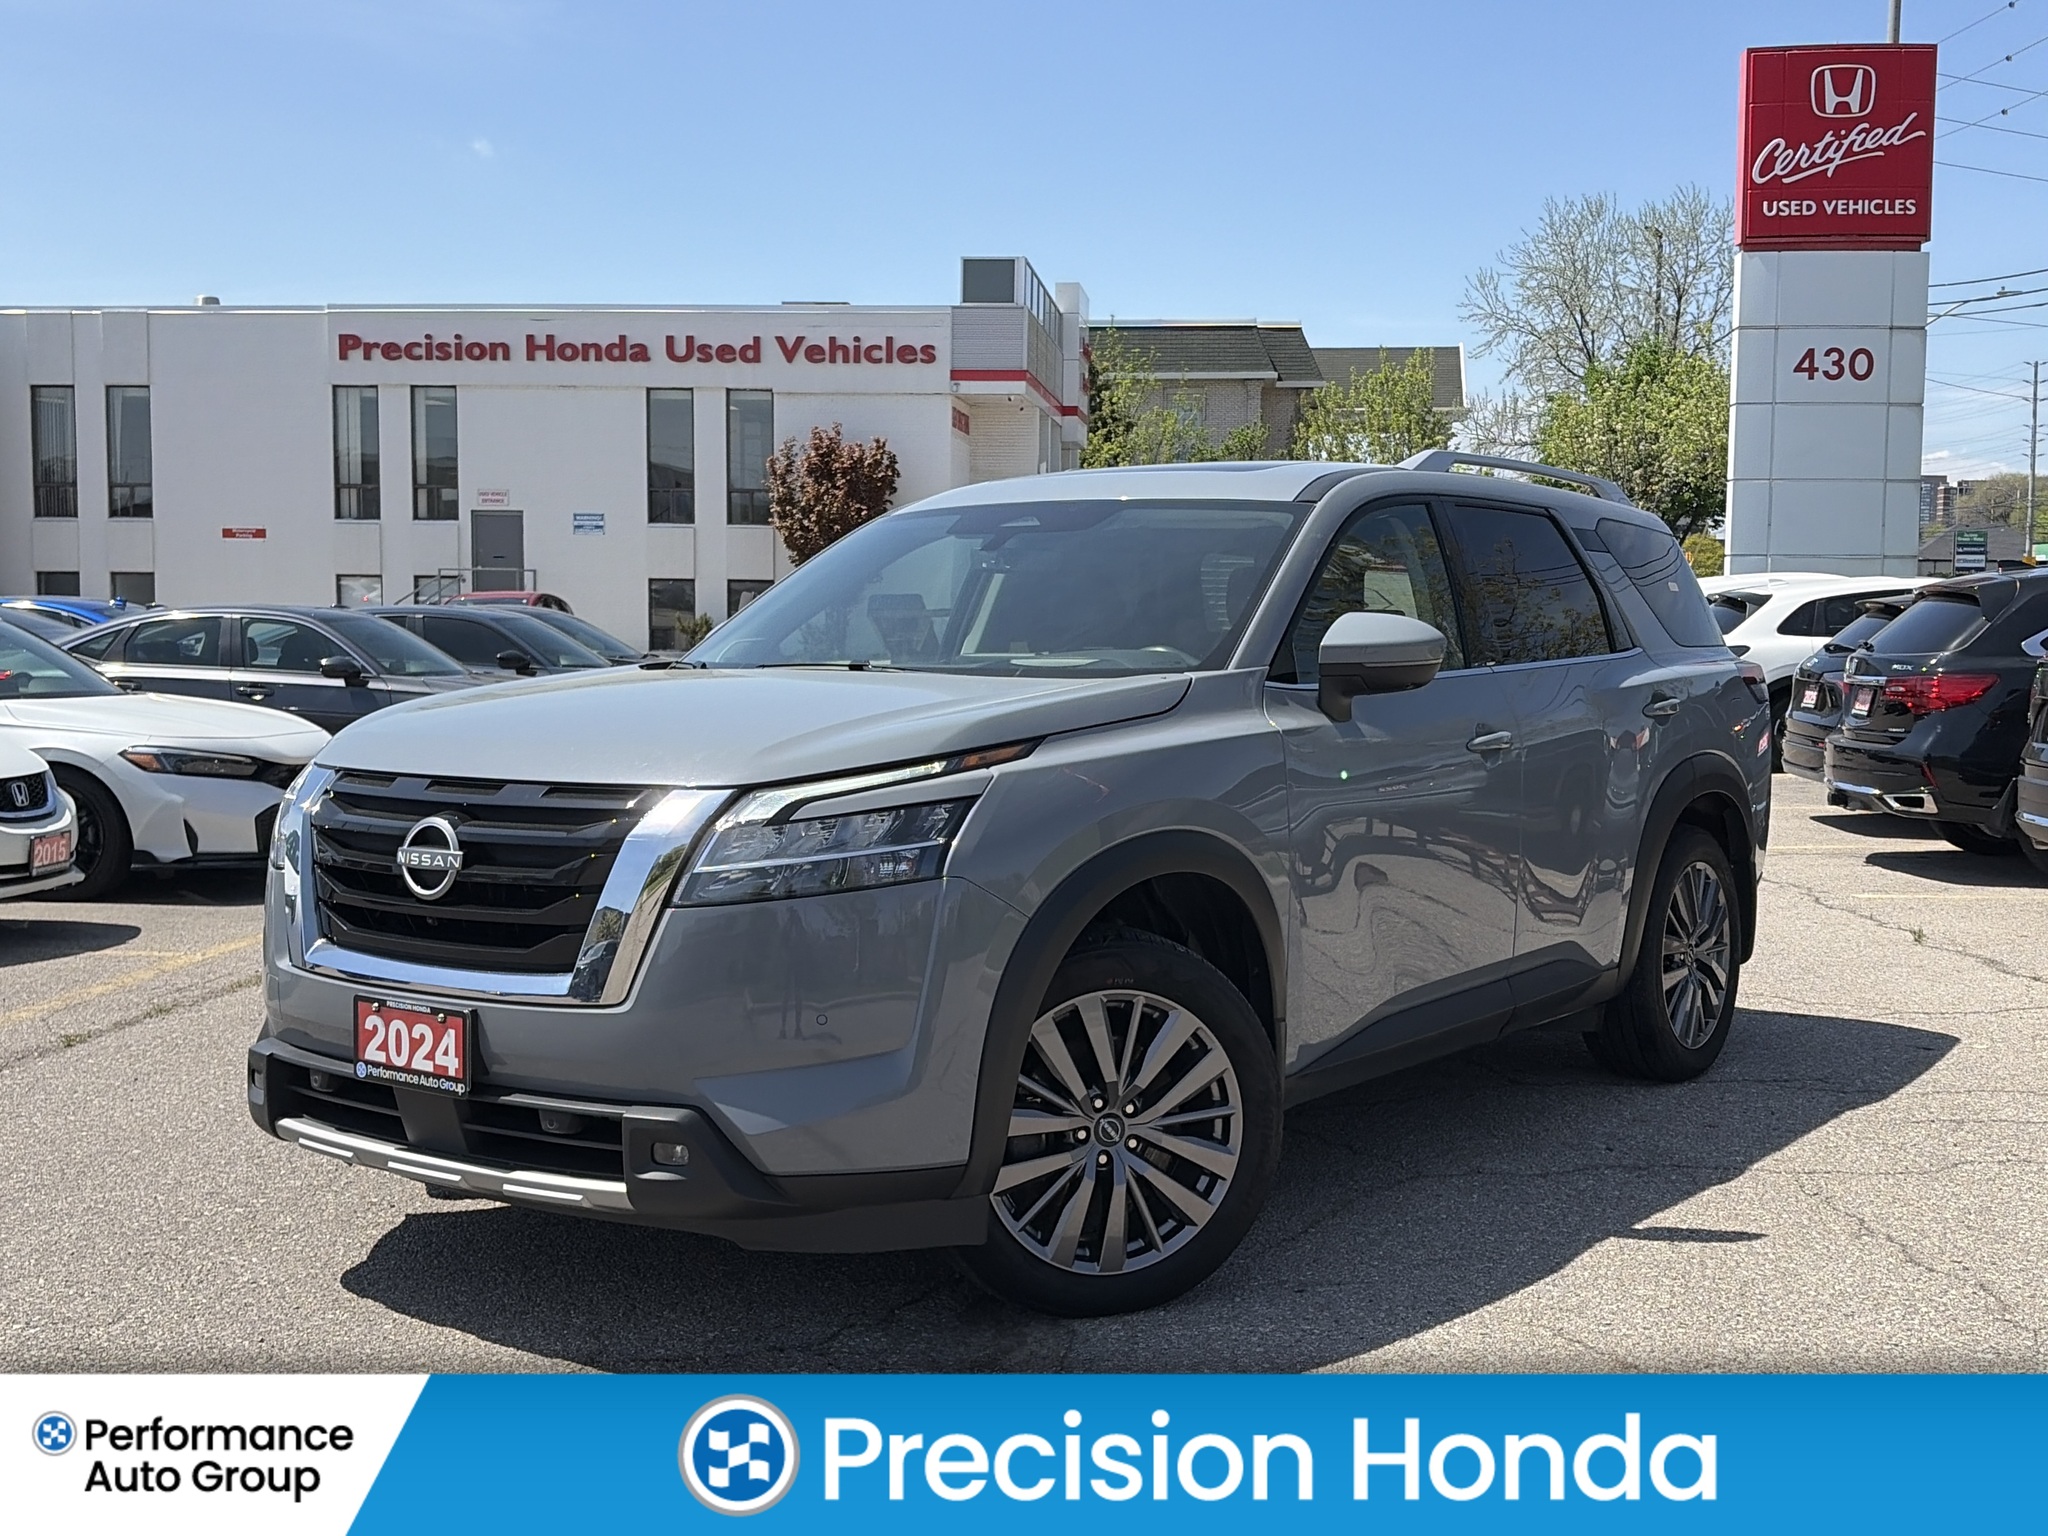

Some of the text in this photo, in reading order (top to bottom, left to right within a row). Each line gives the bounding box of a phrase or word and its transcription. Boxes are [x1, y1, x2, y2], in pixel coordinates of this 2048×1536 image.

[1751, 112, 1926, 184] Certified
[1763, 199, 1917, 216] USED VEHICLES
[338, 333, 937, 364] Precision Honda Used Vehicles
[1793, 346, 1875, 381] 430
[34, 841, 66, 867] 2015
[398, 850, 460, 868] NISSAN
[386, 1000, 431, 1013] PRECISION HONDA
[364, 1014, 459, 1077] 2024
[367, 1064, 466, 1096] Performance Auto Group
